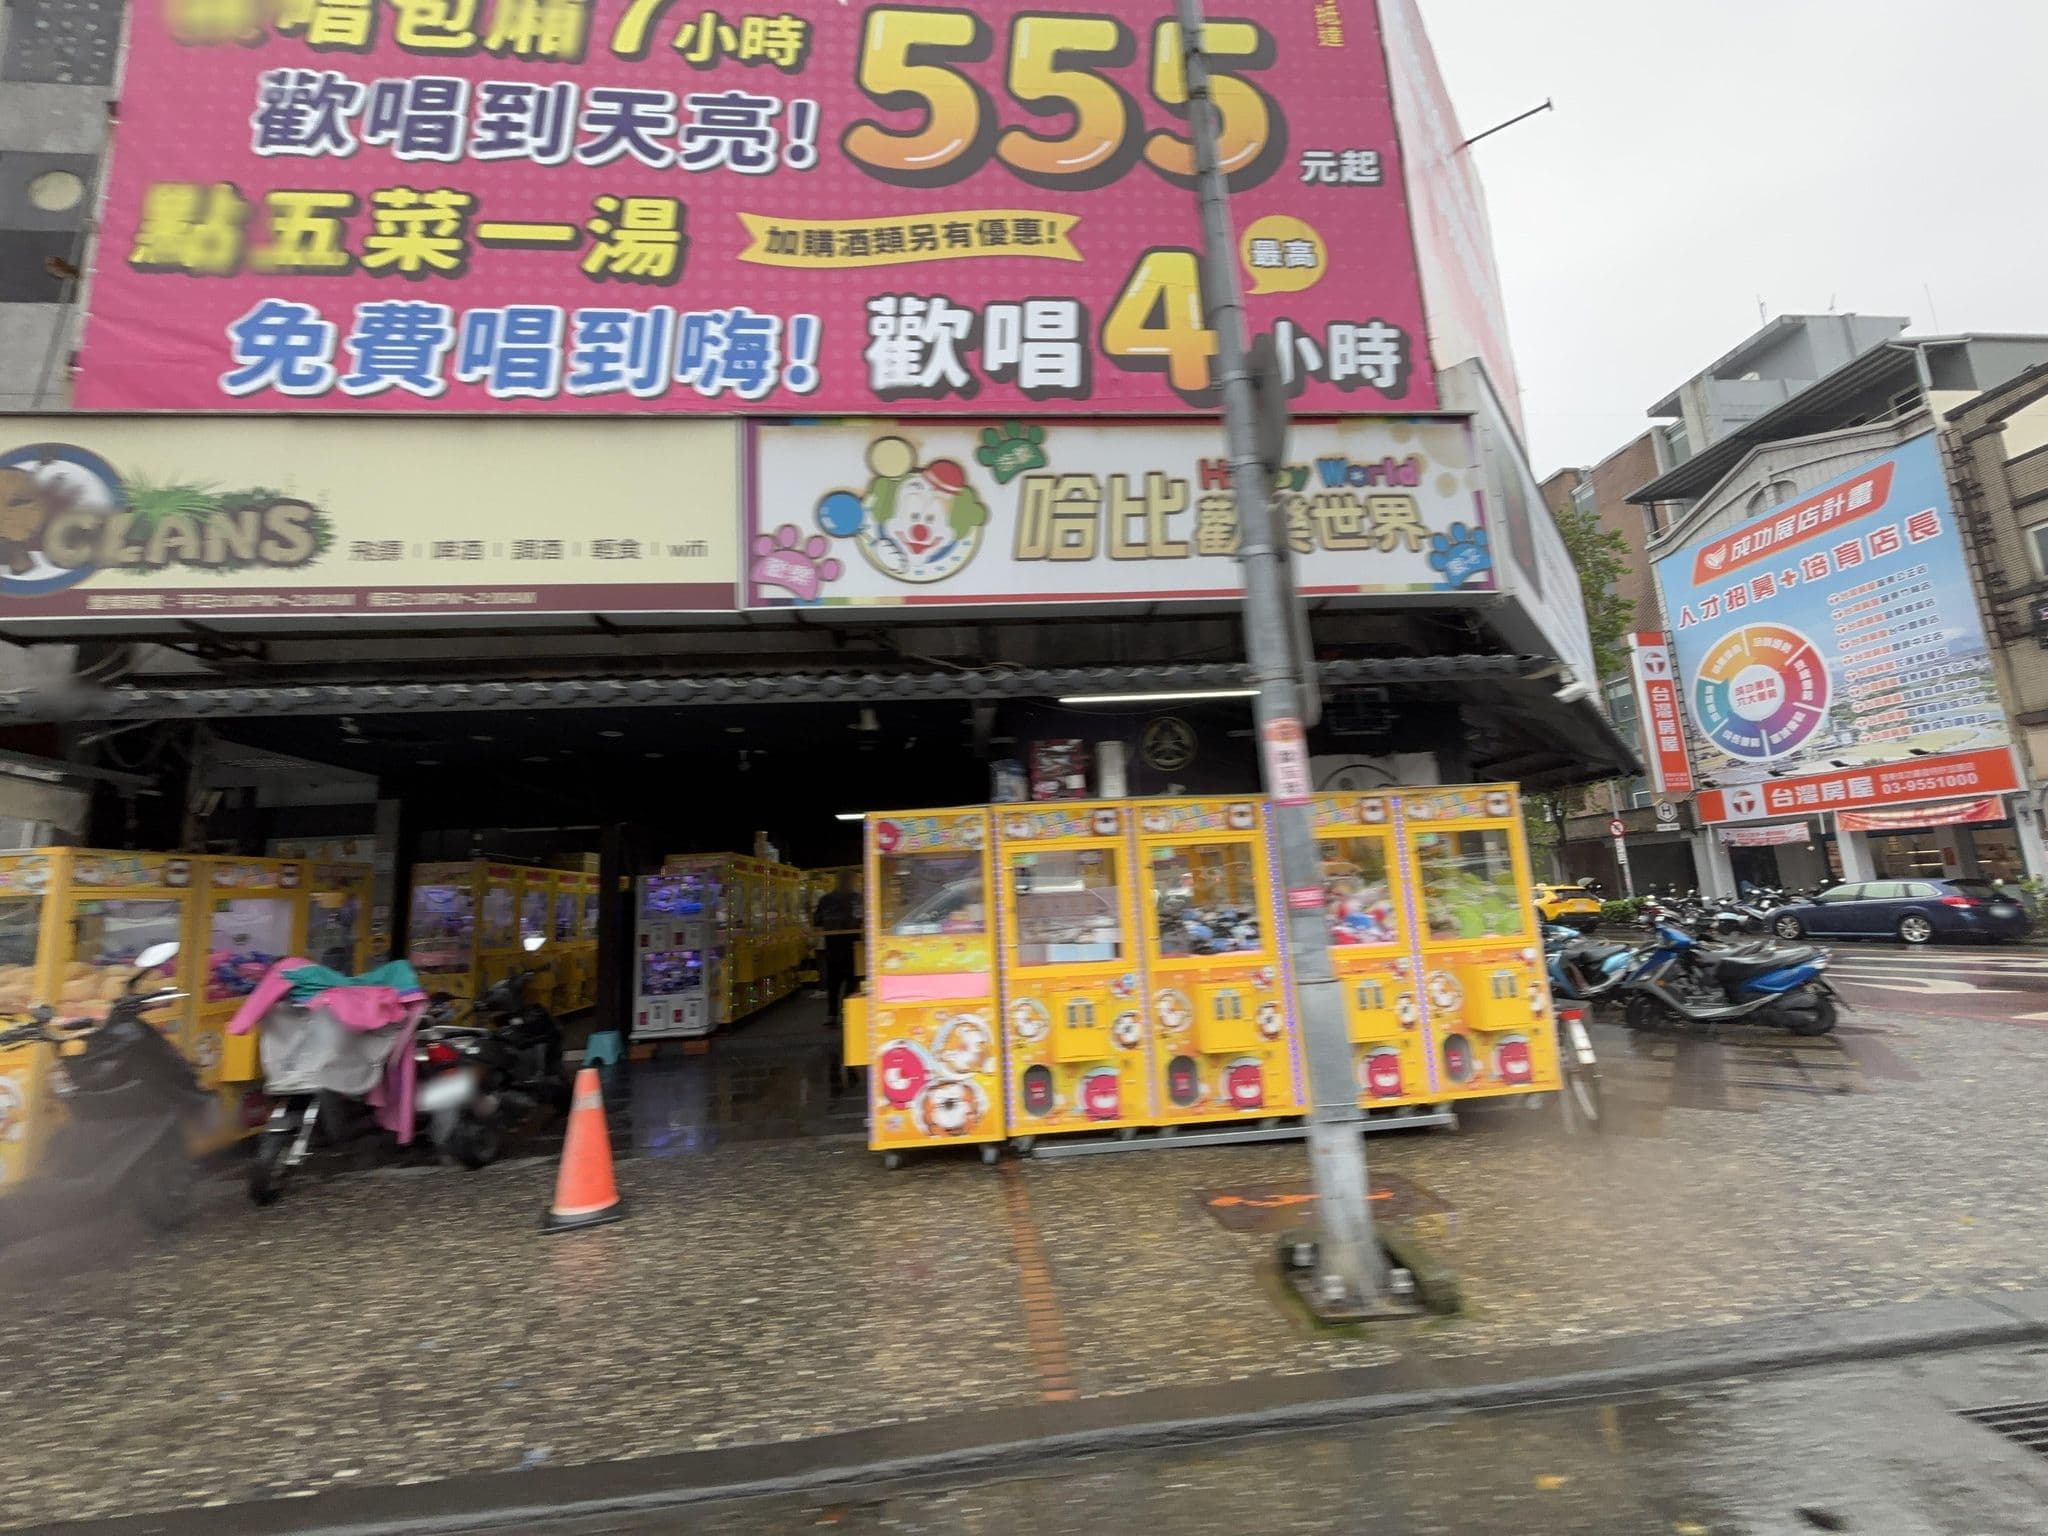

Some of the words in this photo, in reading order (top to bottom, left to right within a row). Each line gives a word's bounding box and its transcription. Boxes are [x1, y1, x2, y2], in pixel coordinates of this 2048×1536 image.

[256, 70, 818, 173] 歡唱到天亮!
[846, 6, 1272, 178] 555
[1300, 149, 1381, 185] 元起
[765, 218, 1056, 257] 加購酒類另有優惠!
[1249, 238, 1318, 270] 最高
[221, 299, 820, 398] 免費唱到嗨!
[42, 504, 316, 568] CLANS
[1651, 685, 1681, 753] 台灣房屋
[1771, 776, 1875, 808] 台灣房屋
[1882, 772, 1979, 795] 03-9551000
